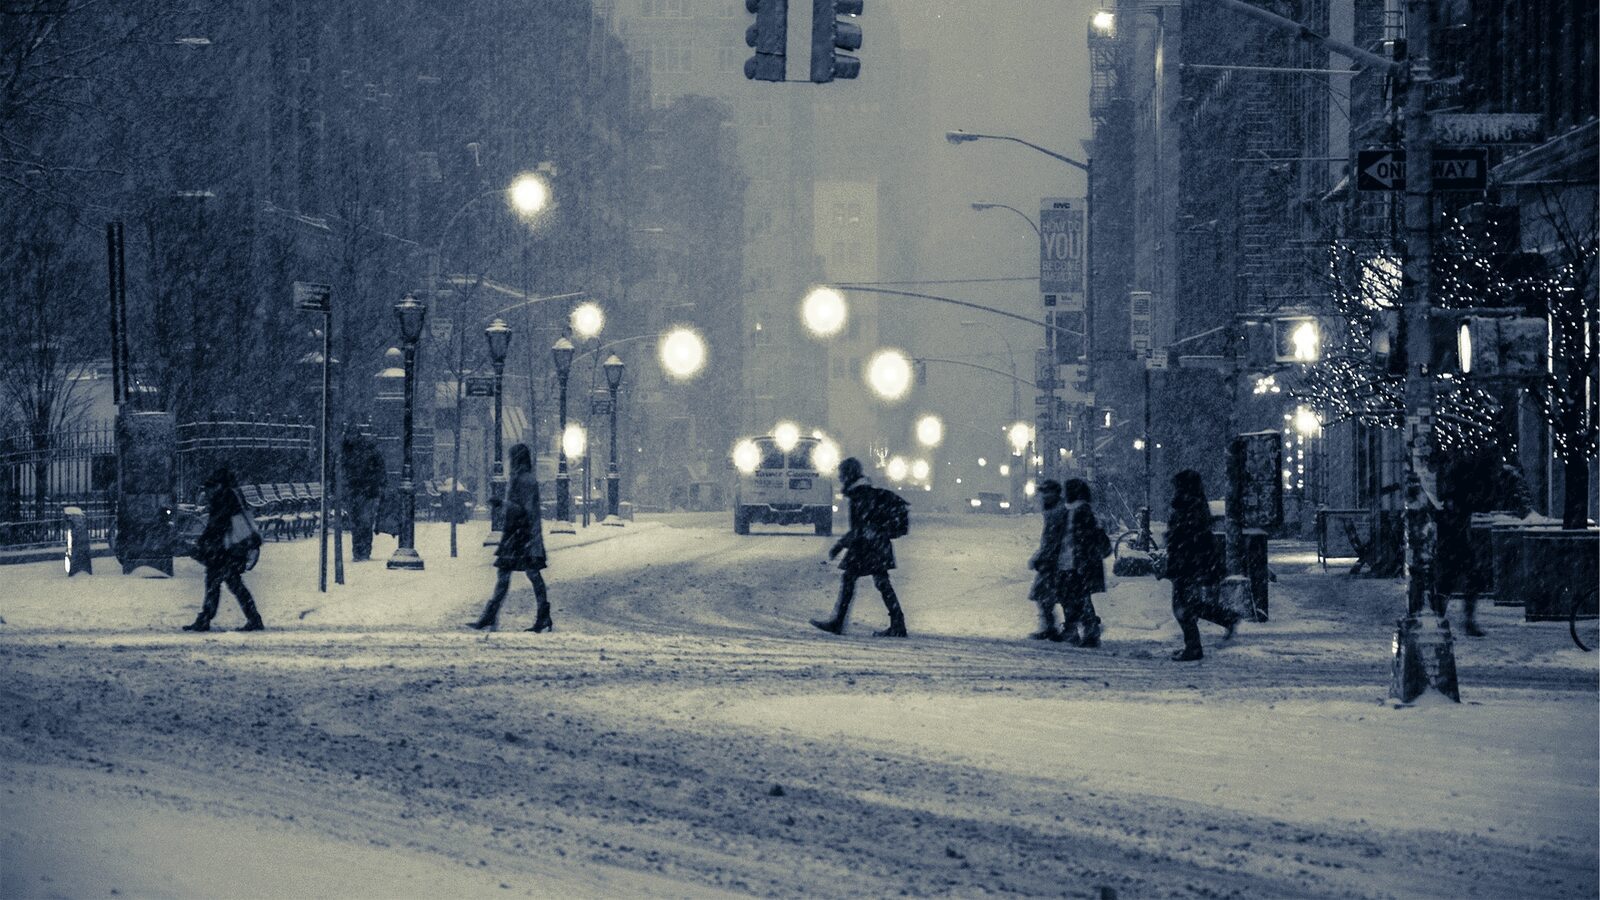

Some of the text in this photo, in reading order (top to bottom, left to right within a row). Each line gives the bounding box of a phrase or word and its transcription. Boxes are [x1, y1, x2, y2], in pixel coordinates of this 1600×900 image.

[1376, 161, 1469, 179] ON WAY
[1042, 220, 1081, 232] HOW DO
[1043, 232, 1082, 260] YOU
[1042, 260, 1082, 271] BECOME
